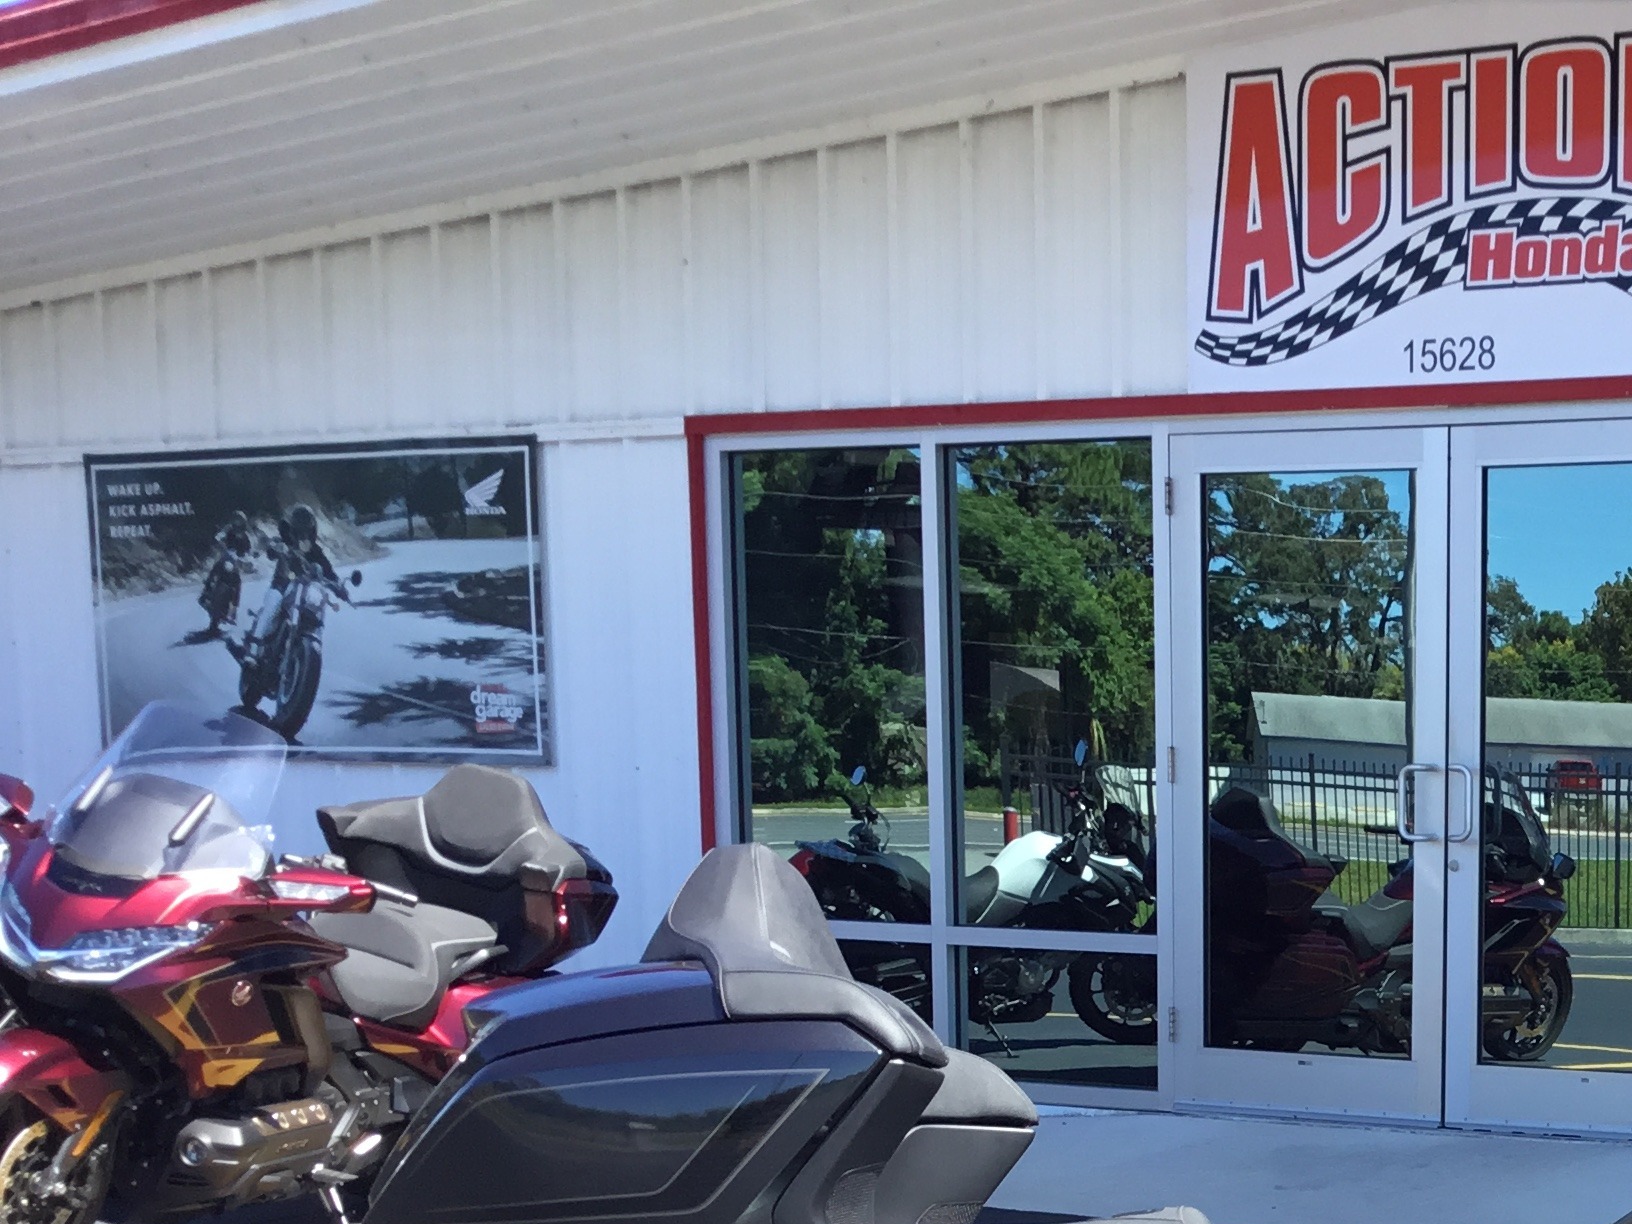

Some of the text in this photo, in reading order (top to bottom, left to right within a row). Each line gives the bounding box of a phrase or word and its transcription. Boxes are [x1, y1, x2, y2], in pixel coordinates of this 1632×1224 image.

[1403, 334, 1497, 374] 15628
[106, 483, 141, 497] WAKE
[109, 504, 136, 518] KICK
[465, 506, 507, 516] HONDA
[470, 684, 517, 706] dream
[475, 704, 524, 723] garage
